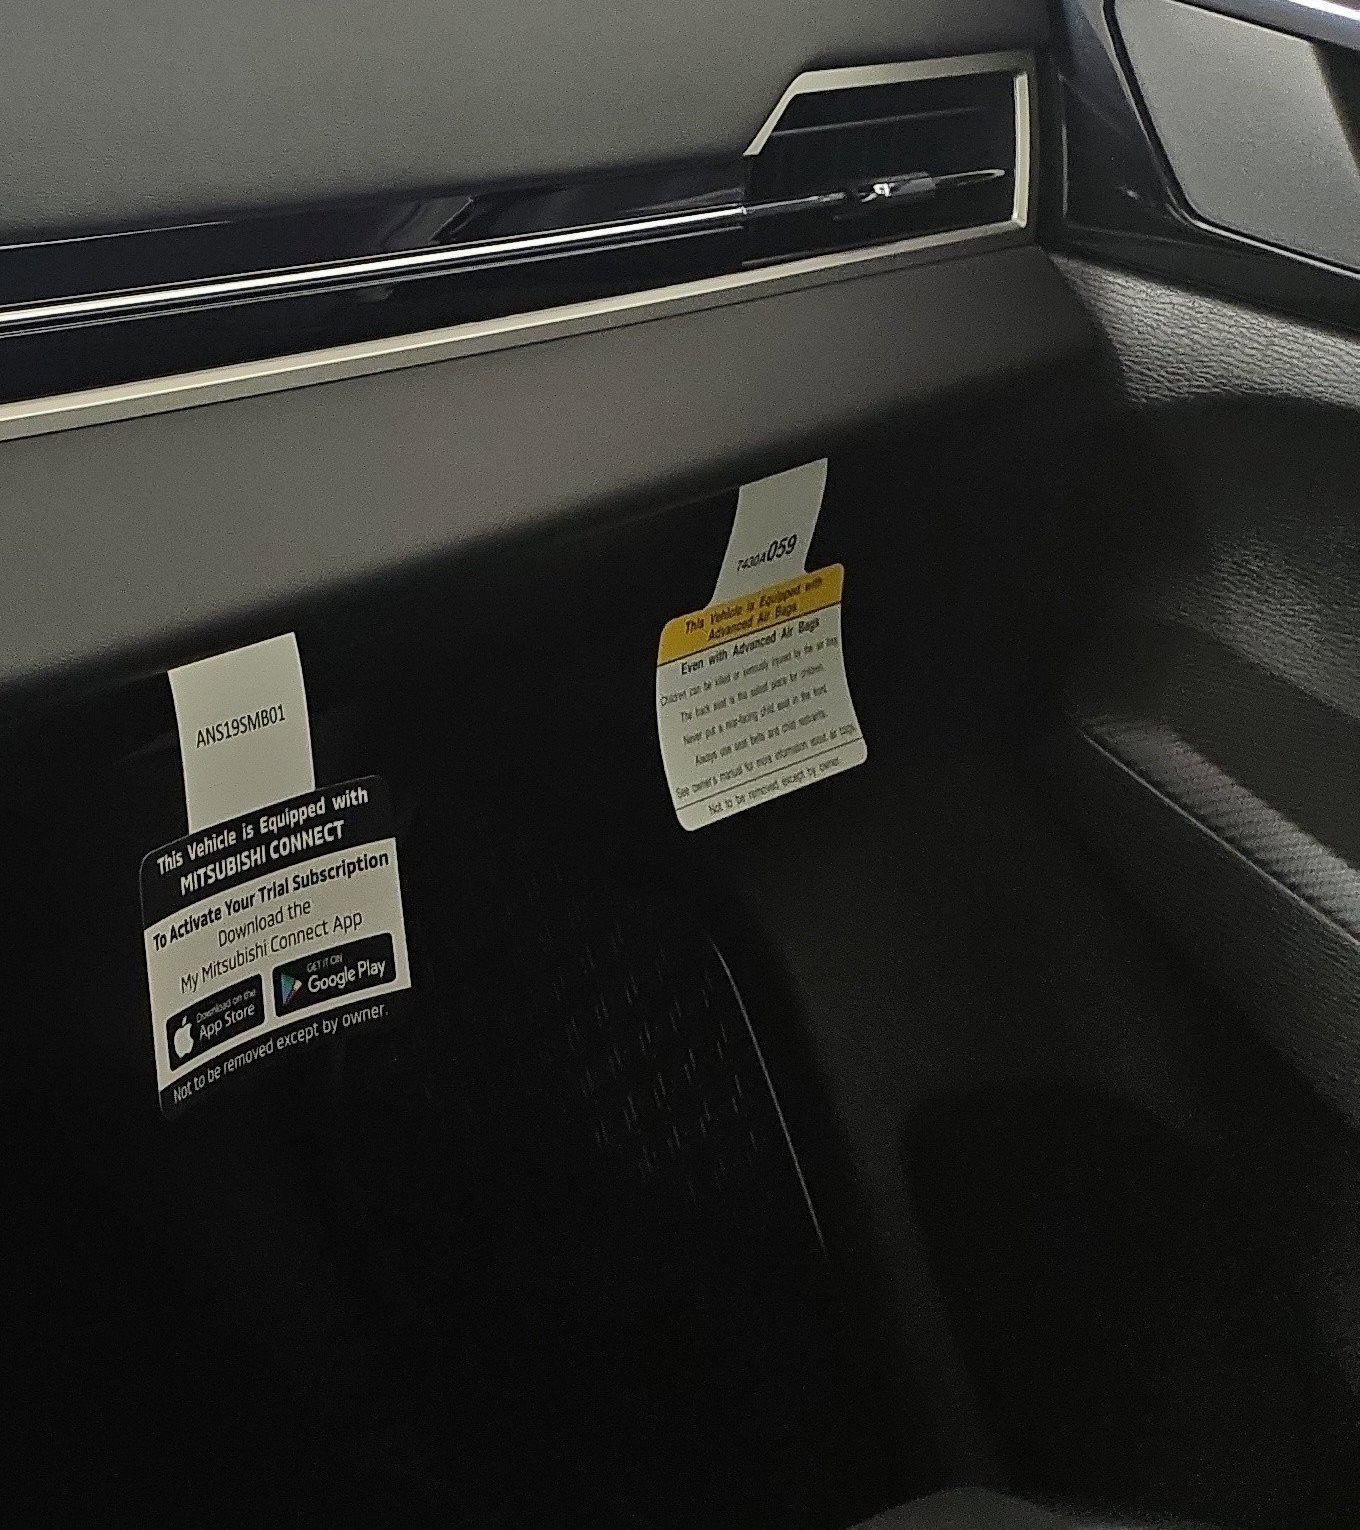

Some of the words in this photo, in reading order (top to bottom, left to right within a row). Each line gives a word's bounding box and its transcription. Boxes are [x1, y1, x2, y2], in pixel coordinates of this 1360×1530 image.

[682, 659, 703, 675] Even
[196, 703, 286, 749] ANS19SMB01
[156, 851, 183, 876] This
[187, 829, 237, 861] Vehicle
[242, 822, 254, 840] is
[259, 796, 326, 835] Equipped
[332, 786, 369, 810] with
[180, 844, 266, 896] MITSUBISHI
[269, 820, 345, 860] CONNECT
[152, 932, 168, 952] To
[169, 907, 222, 944] Activate
[224, 892, 256, 917] Your
[257, 876, 290, 904] Trial
[292, 850, 389, 892] Subscription
[218, 906, 284, 948] Download
[287, 899, 311, 918] the
[180, 970, 199, 994] My
[201, 941, 268, 985] Mitsubishi
[270, 920, 328, 954] Connect
[332, 910, 363, 933] App
[307, 965, 356, 994] Google
[357, 958, 387, 980] Play
[199, 1020, 223, 1041] App
[224, 1003, 256, 1028] Store
[173, 1083, 193, 1105] Not
[194, 1073, 206, 1089] to
[207, 1065, 221, 1084] be
[223, 1037, 274, 1075] removed
[277, 1022, 319, 1050] except
[322, 1016, 339, 1036] by
[341, 1003, 389, 1027] owner.
